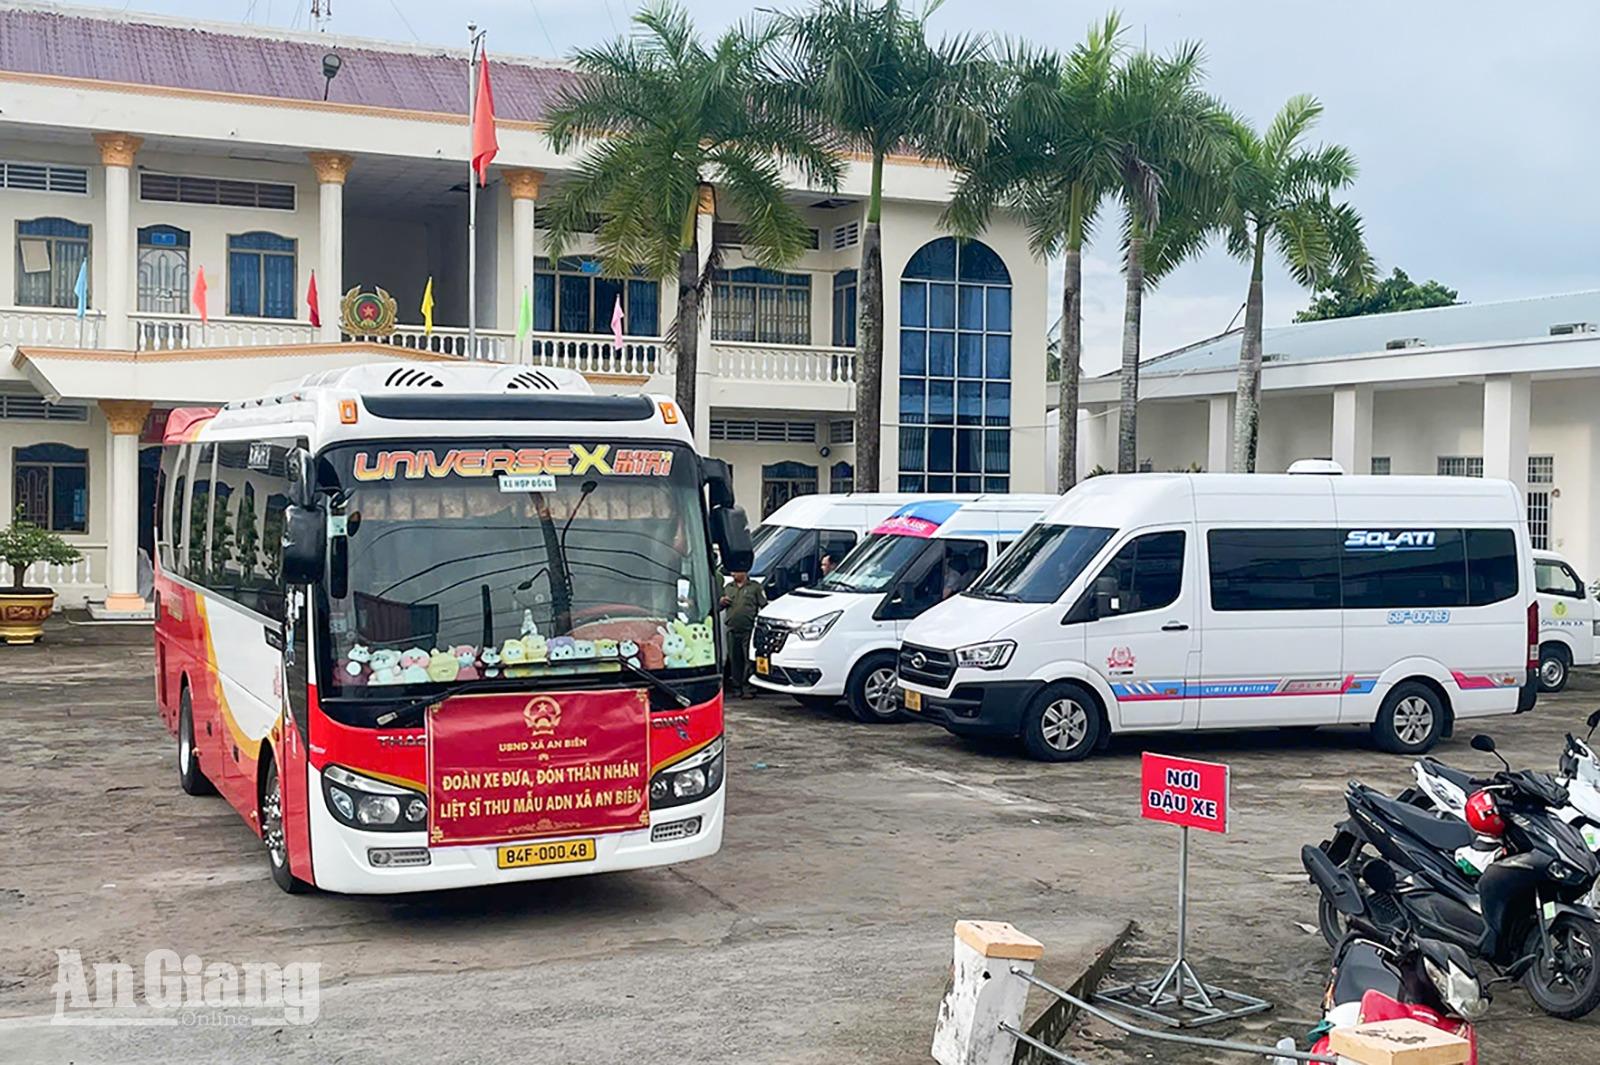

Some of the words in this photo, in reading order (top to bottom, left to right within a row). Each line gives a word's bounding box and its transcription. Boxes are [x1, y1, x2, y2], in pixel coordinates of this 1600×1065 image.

[1344, 530, 1436, 546] SOLATI
[499, 742, 528, 752] UBND
[530, 739, 545, 750] XÃ
[547, 740, 562, 749] AN
[564, 736, 587, 748] BIÊN
[442, 769, 480, 791] ĐOÀN
[483, 773, 500, 788] XE
[502, 769, 534, 787] ĐƯA,
[536, 765, 565, 785] ĐÓN
[566, 762, 601, 782] THÂN
[603, 759, 639, 779] NHÂN
[1166, 768, 1200, 790] NƠI
[440, 799, 467, 821] LIỆT
[469, 797, 482, 817] SĨ
[483, 799, 510, 815] THU
[513, 791, 543, 813] MẪU
[546, 795, 573, 811] ADN
[575, 789, 593, 809] XÃ
[595, 792, 613, 807] AN
[615, 786, 641, 805] BIÊN
[1148, 789, 1187, 814] ĐẬU
[1191, 797, 1217, 819] XE
[506, 843, 588, 864] 84F-000.48
